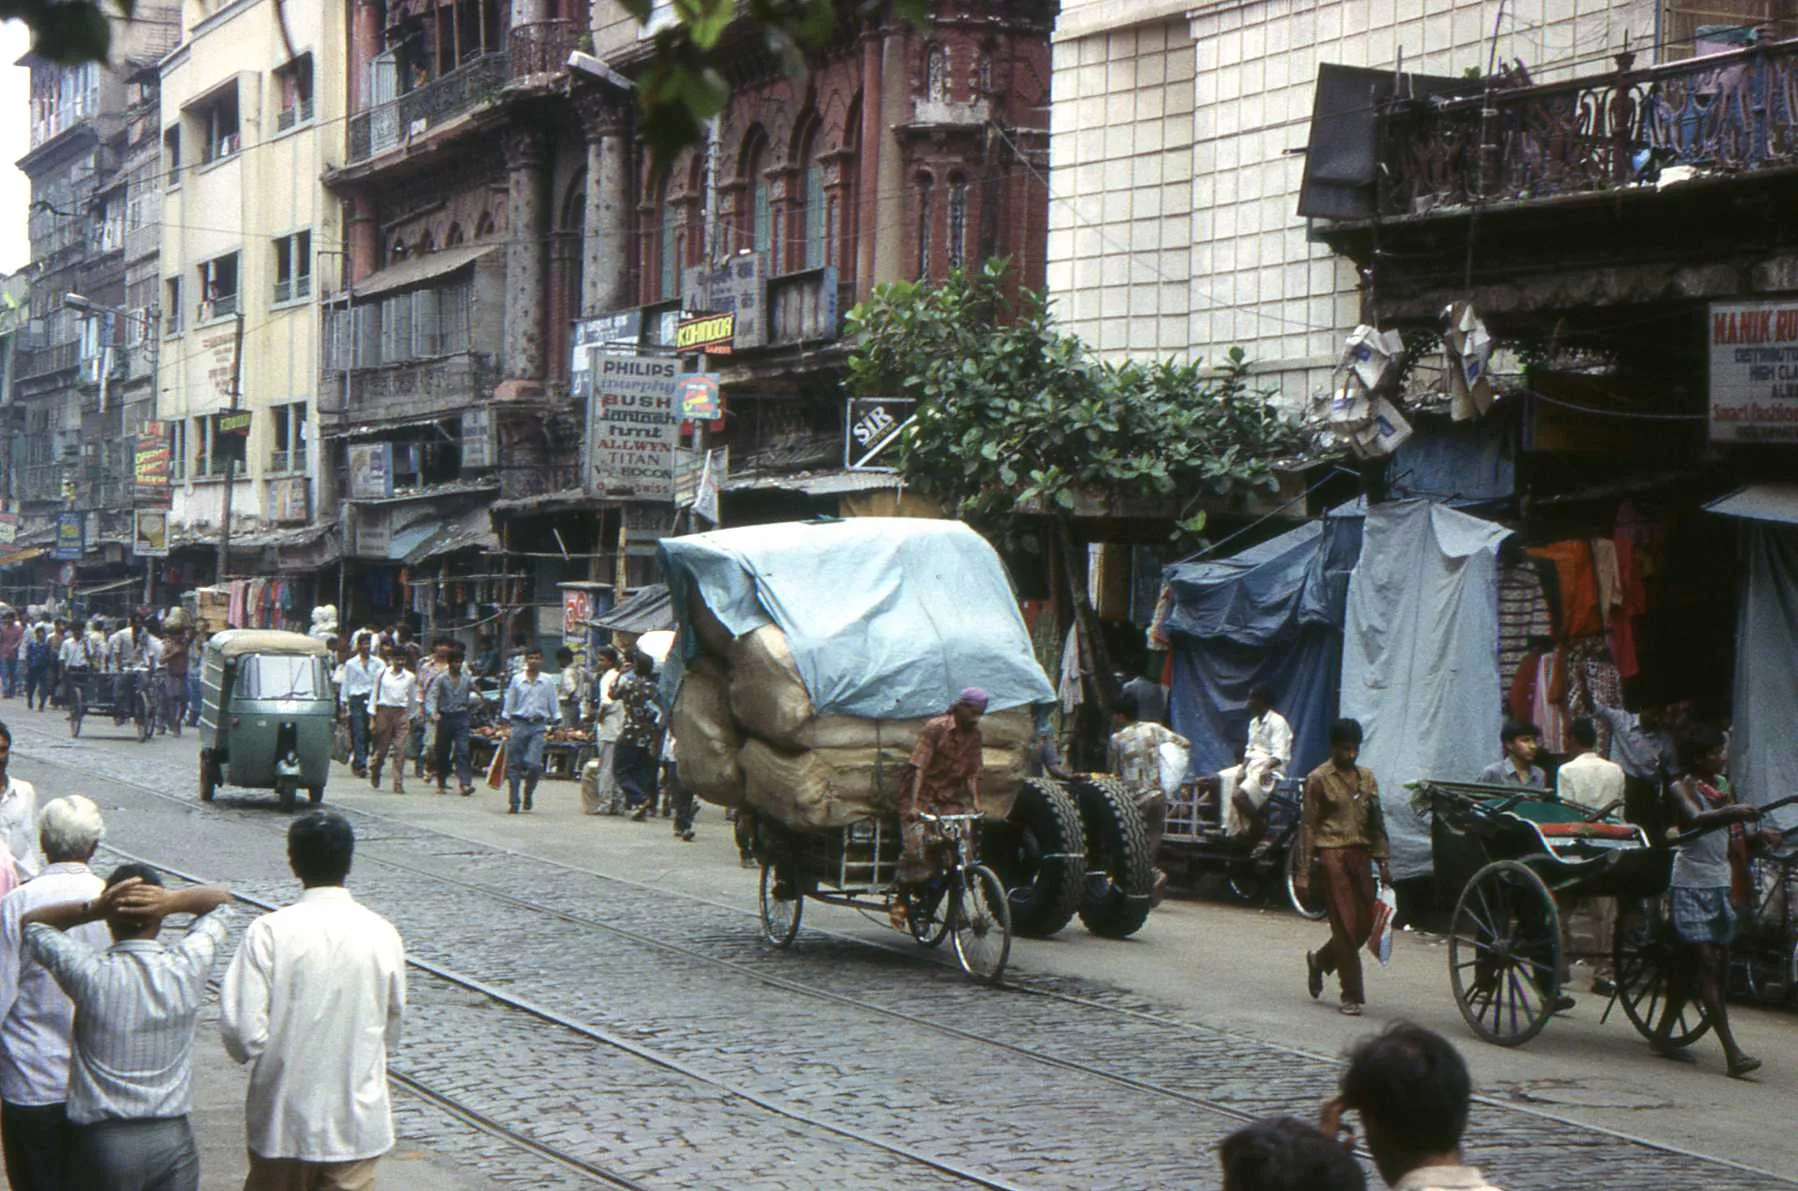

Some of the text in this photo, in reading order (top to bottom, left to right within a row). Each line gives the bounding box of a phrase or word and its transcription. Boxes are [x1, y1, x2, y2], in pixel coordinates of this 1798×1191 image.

[603, 360, 676, 377] PHILIPS
[601, 394, 672, 409] BUSH
[853, 406, 893, 446] SIR
[598, 440, 672, 453] ALLWYN
[609, 452, 660, 465] TITAN
[594, 465, 673, 480] VEOCON
